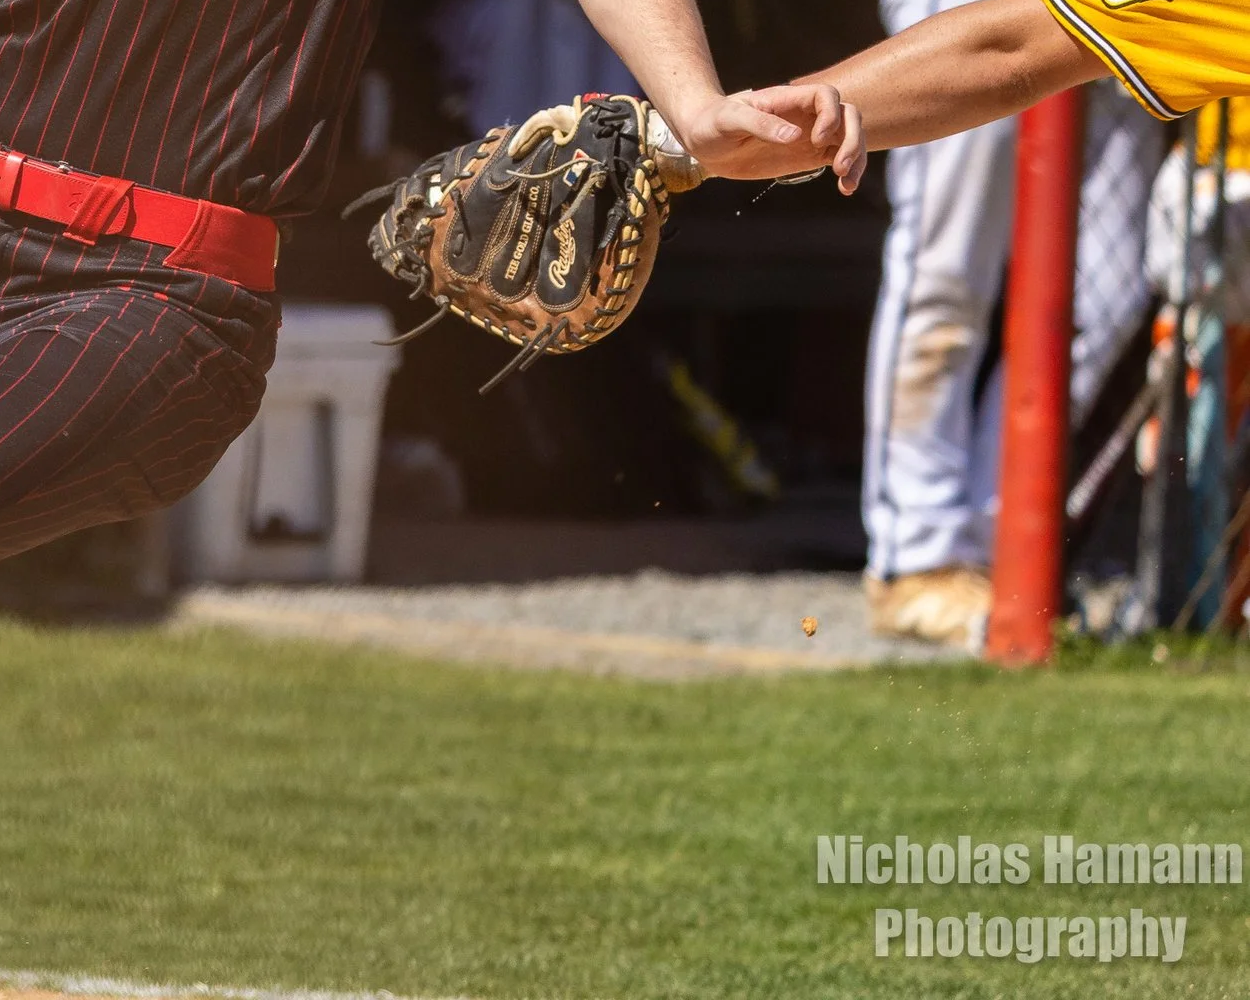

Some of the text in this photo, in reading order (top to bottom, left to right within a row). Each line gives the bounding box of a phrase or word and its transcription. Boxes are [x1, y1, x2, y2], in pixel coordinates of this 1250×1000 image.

[505, 259, 520, 280] THE
[513, 234, 529, 260] GOLD
[549, 218, 575, 289] Rawling
